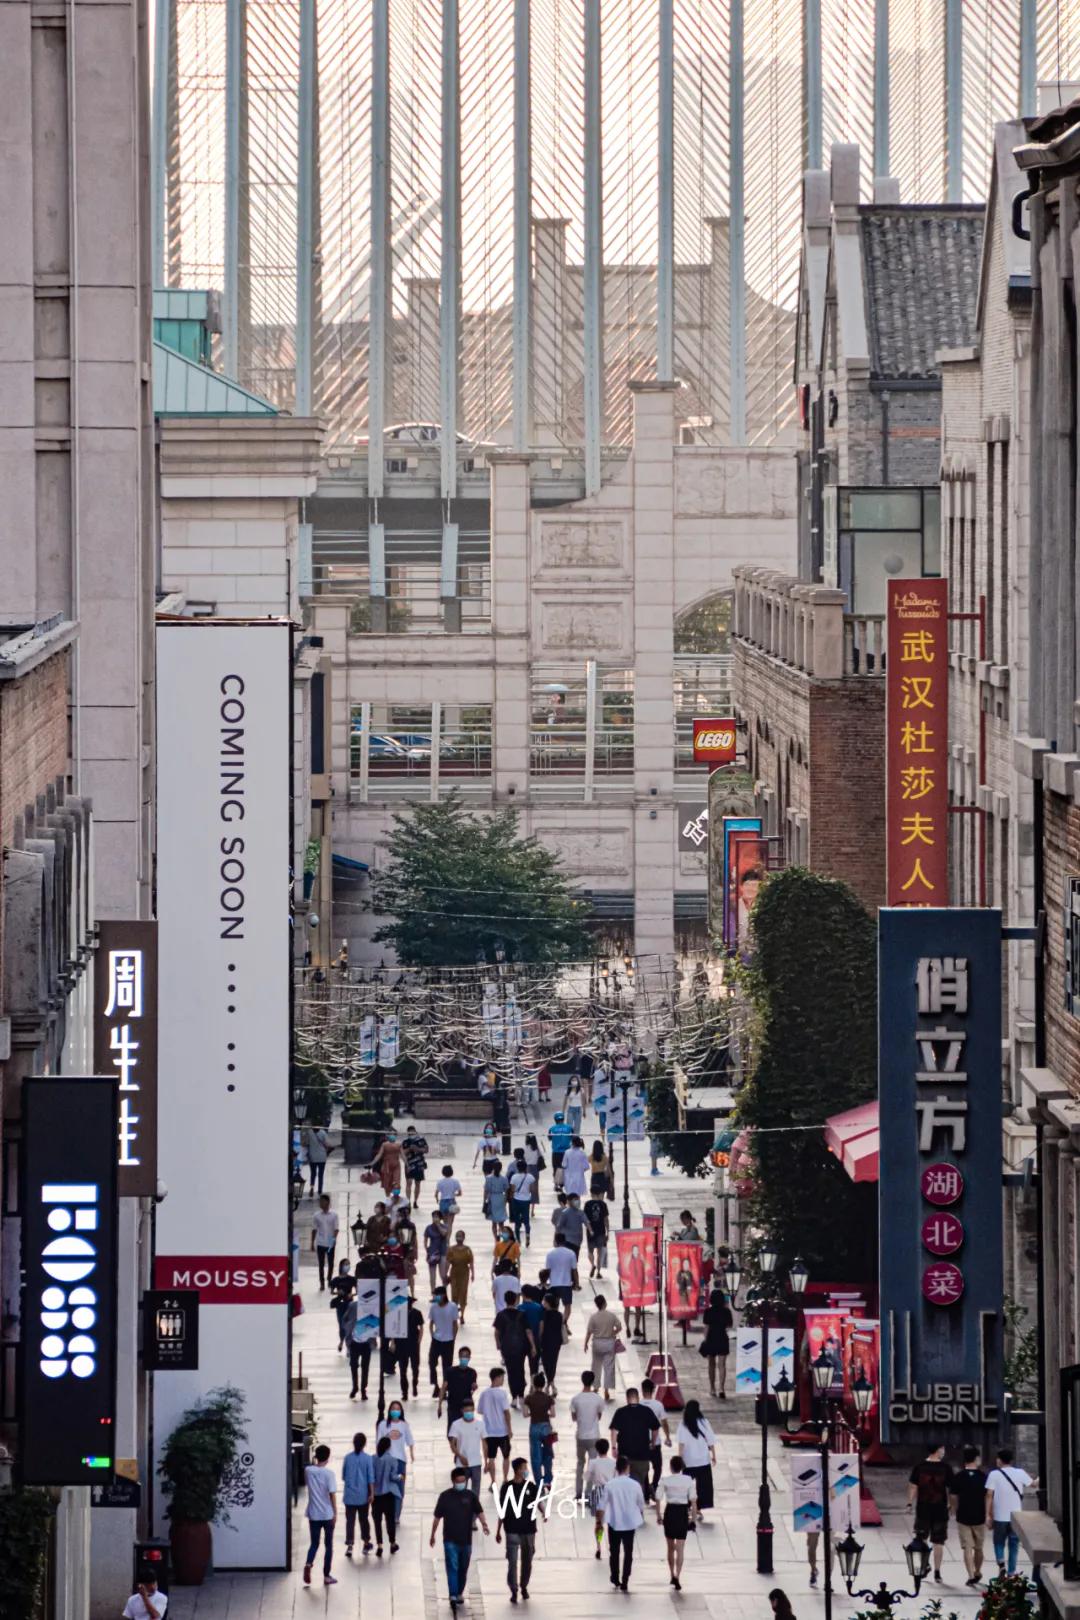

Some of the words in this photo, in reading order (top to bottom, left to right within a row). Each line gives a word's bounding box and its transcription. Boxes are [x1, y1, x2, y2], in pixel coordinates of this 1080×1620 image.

[220, 674, 244, 822] COMING
[697, 733, 732, 748] LEGO
[220, 837, 244, 939] SOON
[915, 957, 968, 1151] 俏立方
[172, 1269, 286, 1288] MOUSSY
[926, 1171, 959, 1297] 湖北菜
